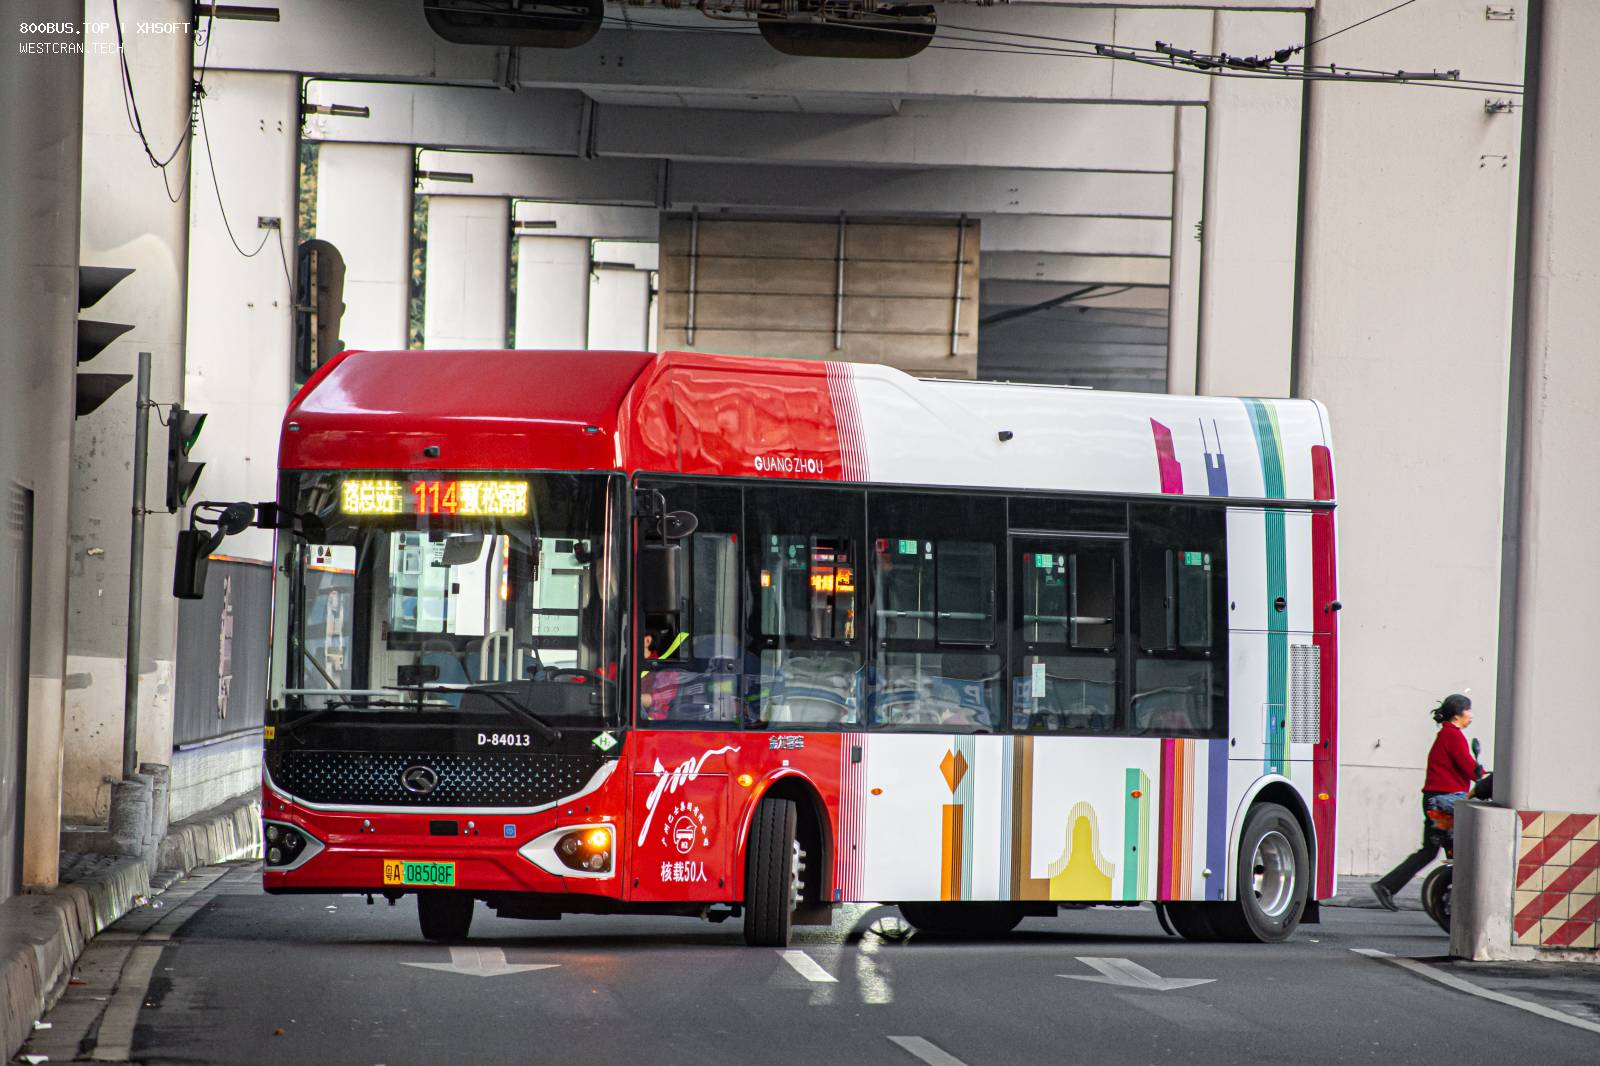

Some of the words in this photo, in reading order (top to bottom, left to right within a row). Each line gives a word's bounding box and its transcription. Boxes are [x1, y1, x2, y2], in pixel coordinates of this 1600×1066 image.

[415, 480, 458, 514] 114
[477, 733, 531, 747] D-84013
[660, 860, 708, 883] 核载50人
